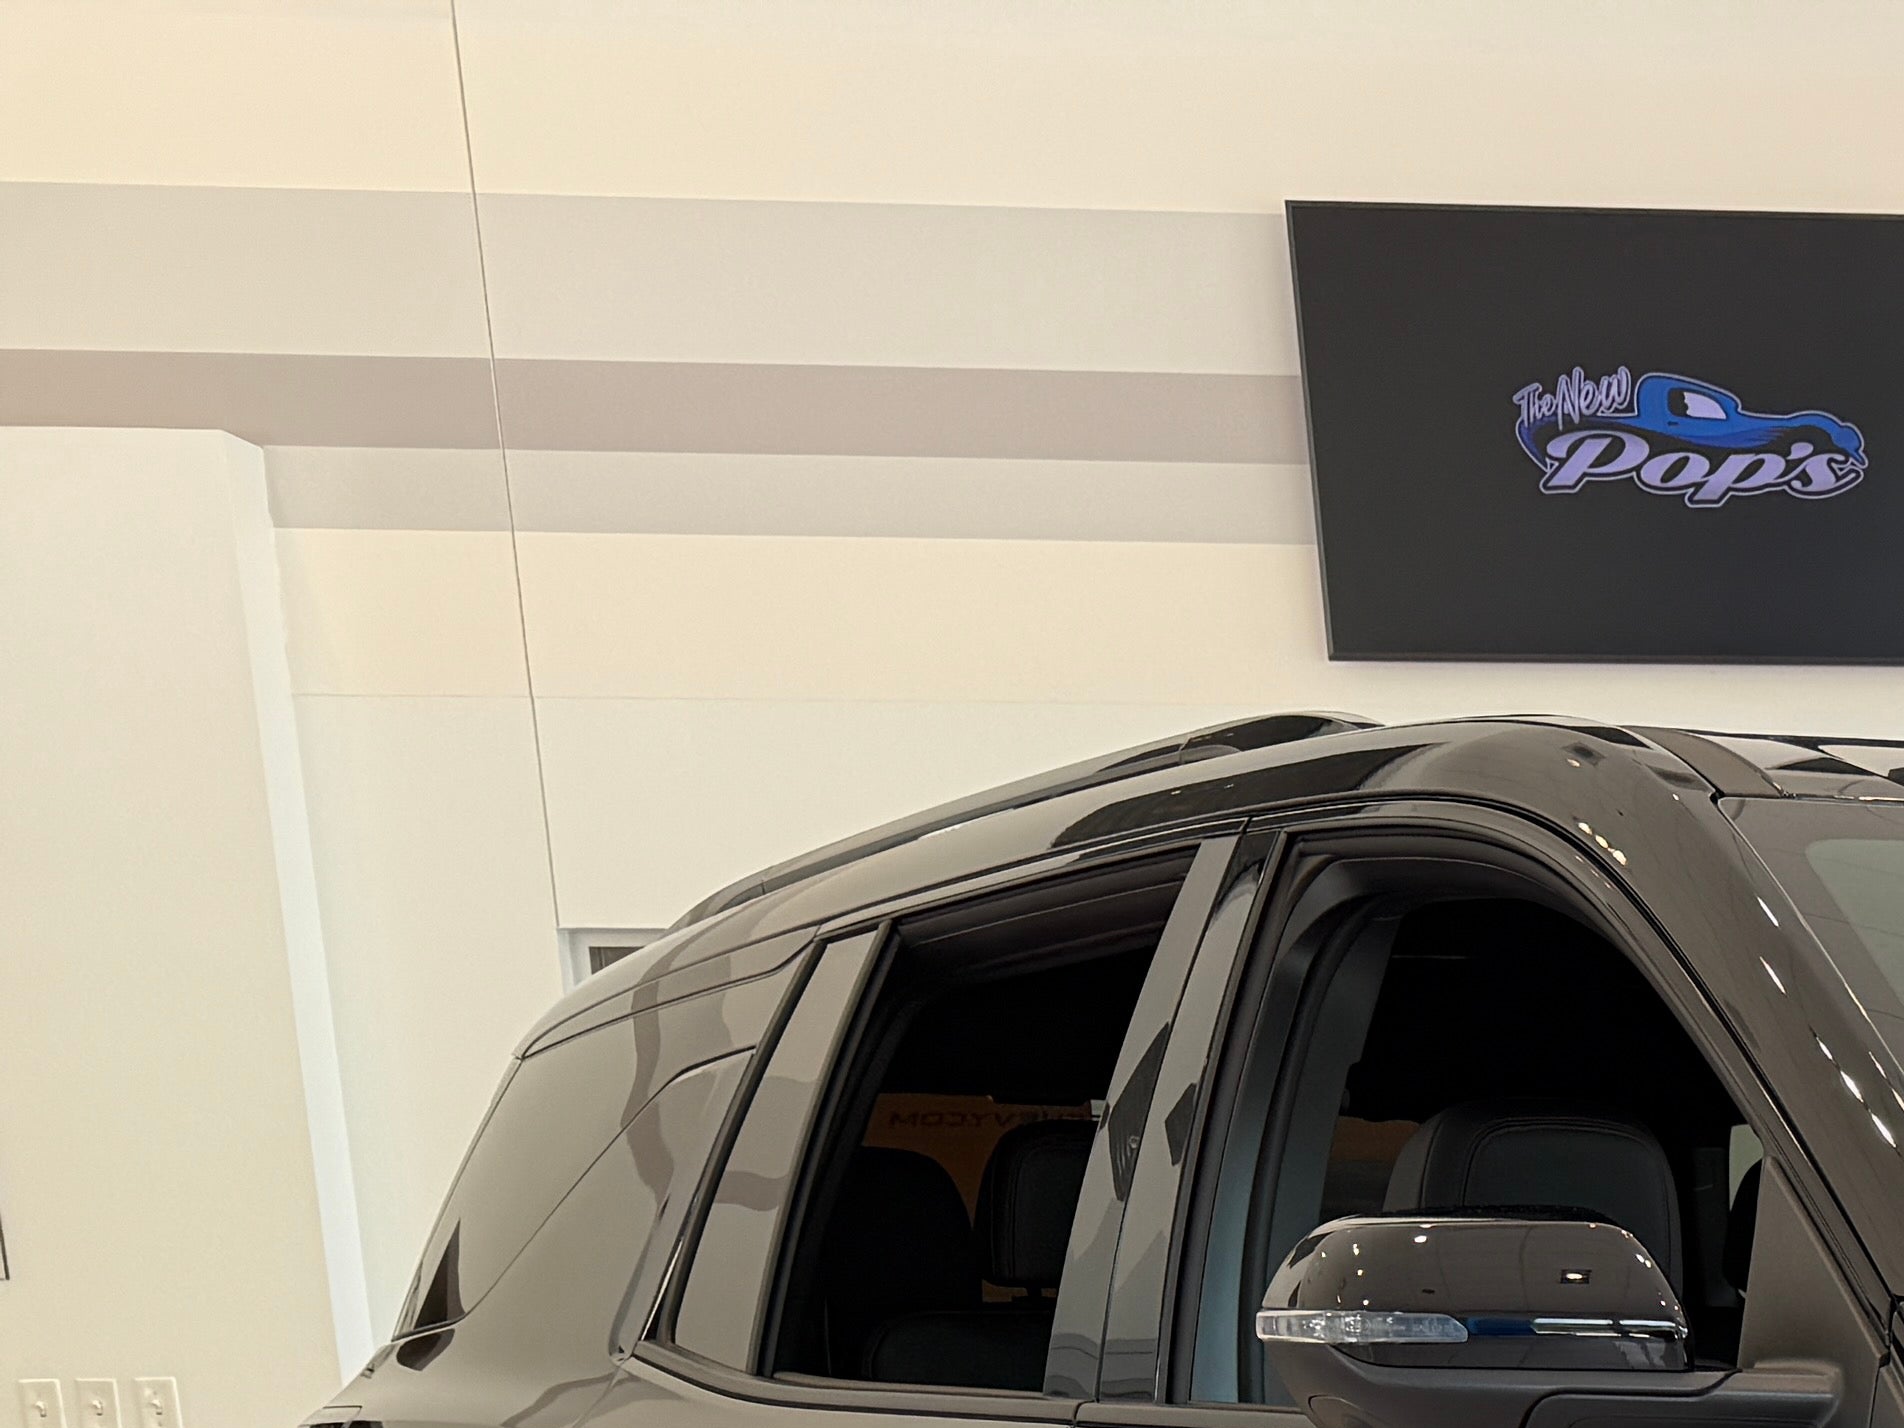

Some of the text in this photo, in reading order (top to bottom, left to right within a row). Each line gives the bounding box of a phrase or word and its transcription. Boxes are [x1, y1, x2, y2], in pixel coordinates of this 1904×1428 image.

[1514, 366, 1631, 430] The New
[1541, 430, 1860, 506] Pop's
